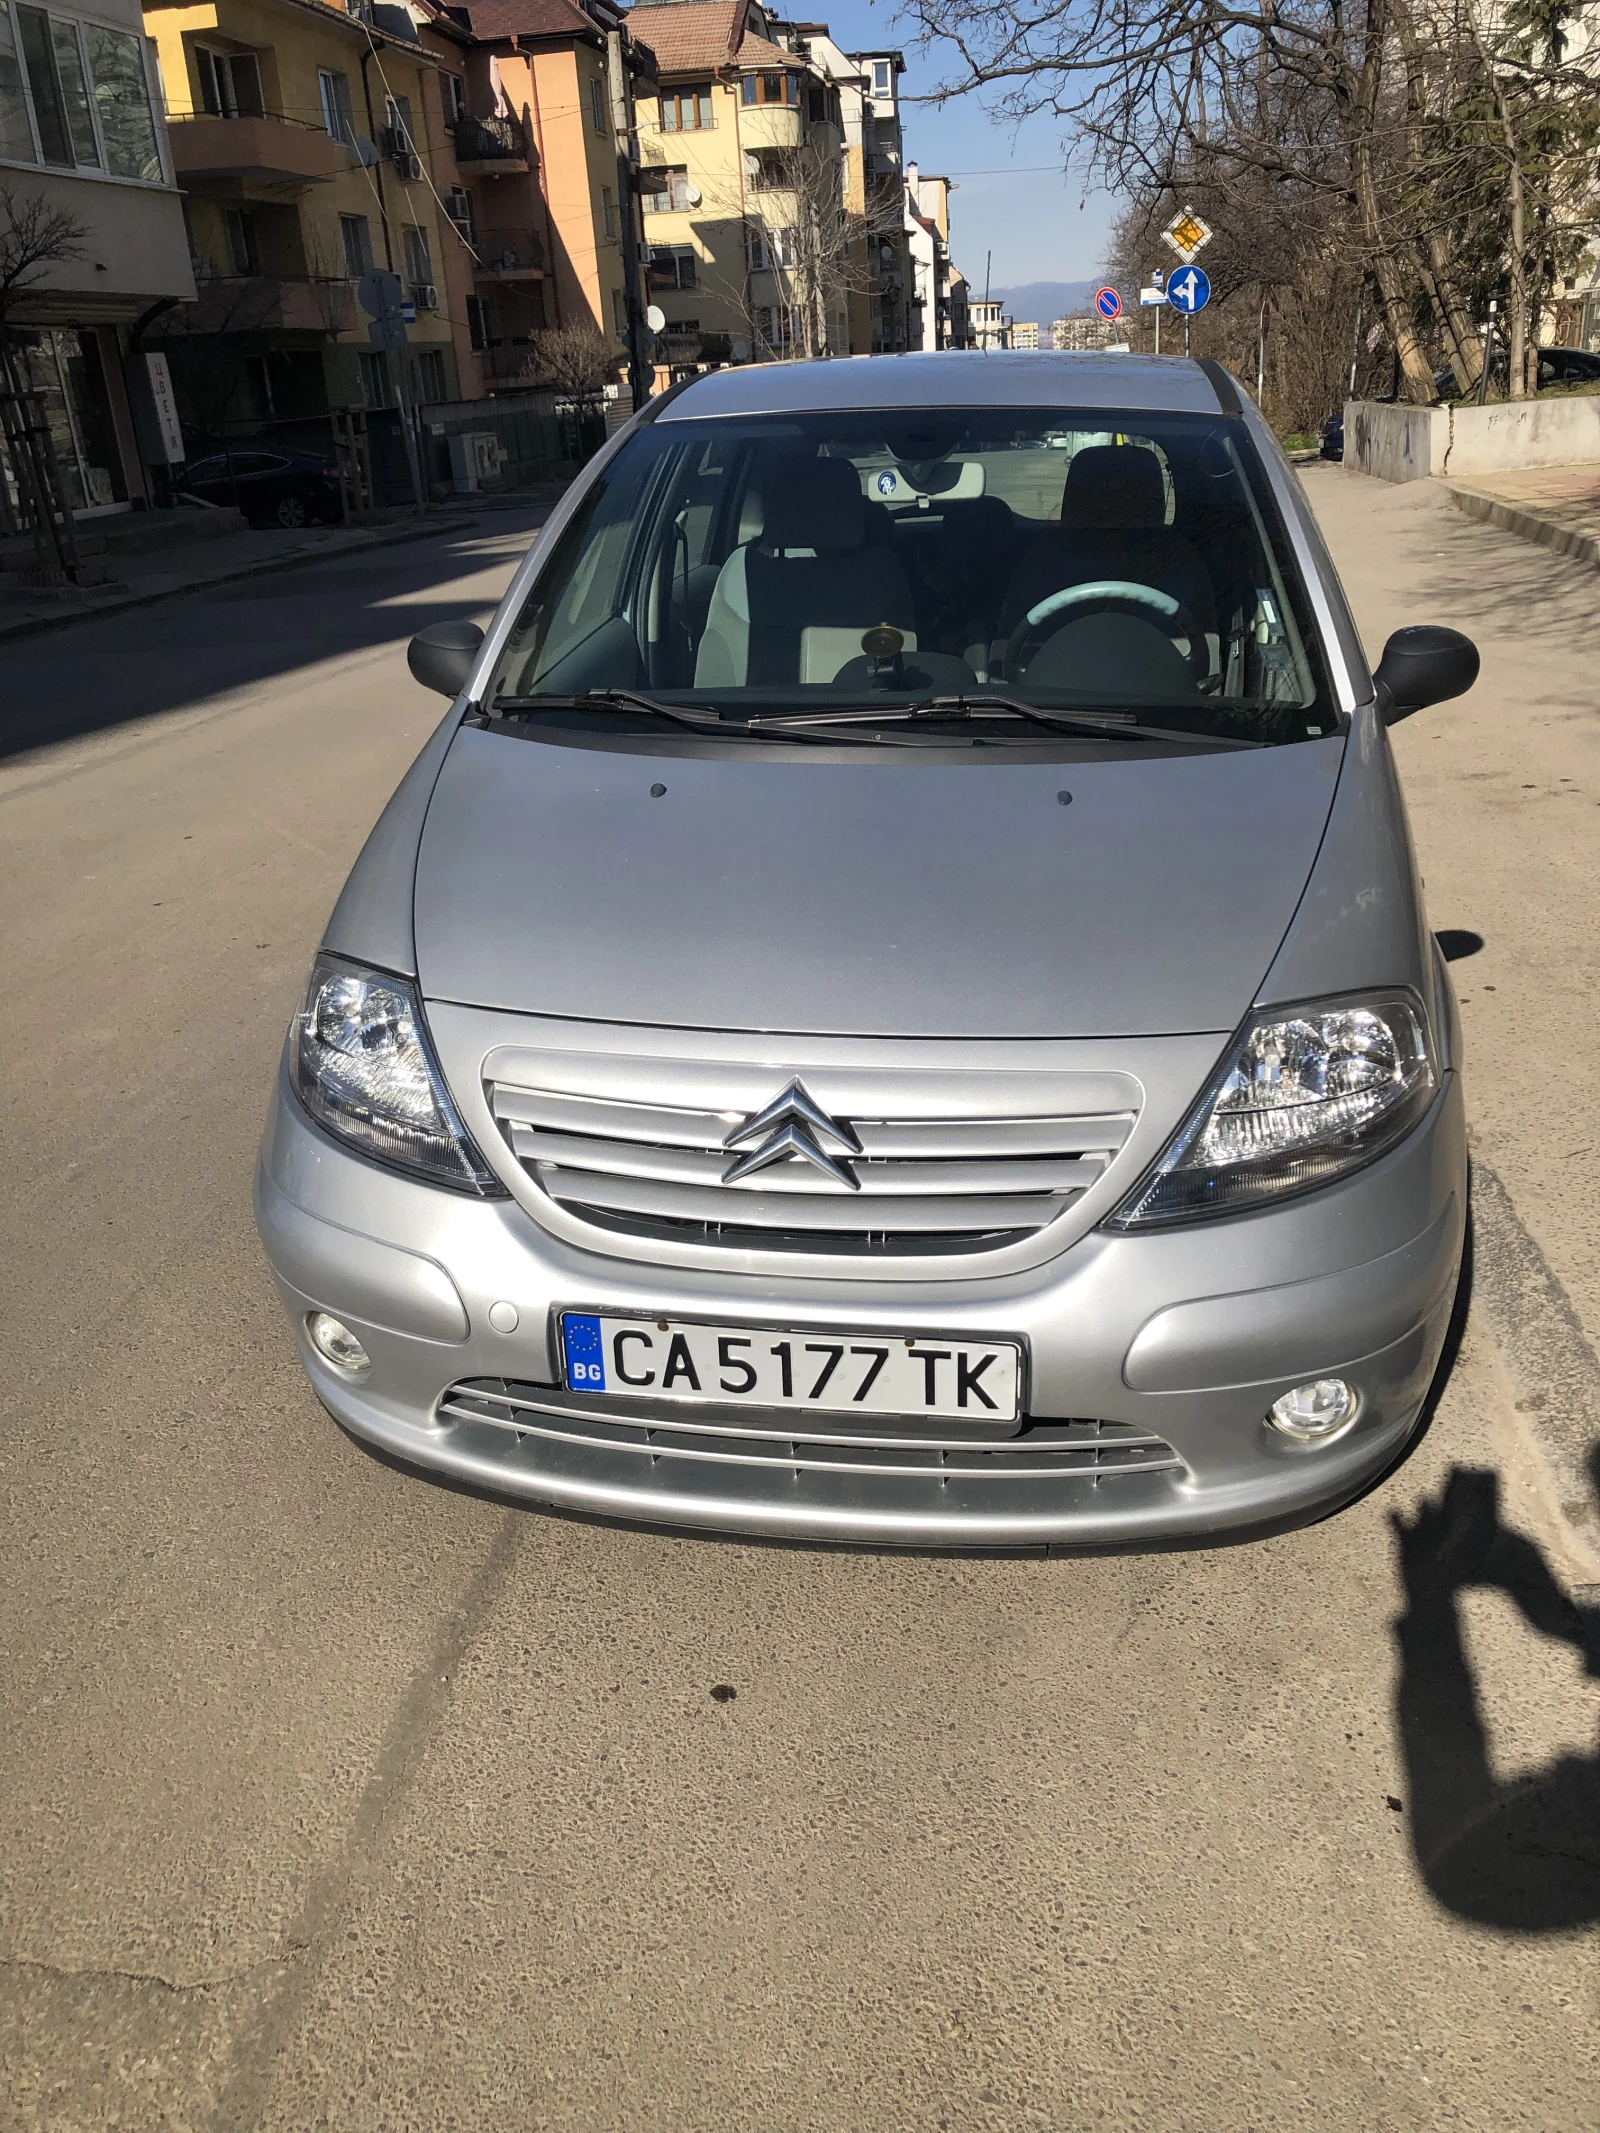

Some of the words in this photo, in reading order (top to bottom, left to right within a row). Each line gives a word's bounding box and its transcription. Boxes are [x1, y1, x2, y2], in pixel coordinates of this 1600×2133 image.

[155, 362, 177, 449] ЦВЕТЯ
[573, 1362, 602, 1381] BG
[612, 1329, 702, 1391] CA
[717, 1334, 890, 1401] 5177
[908, 1348, 1000, 1410] TK
